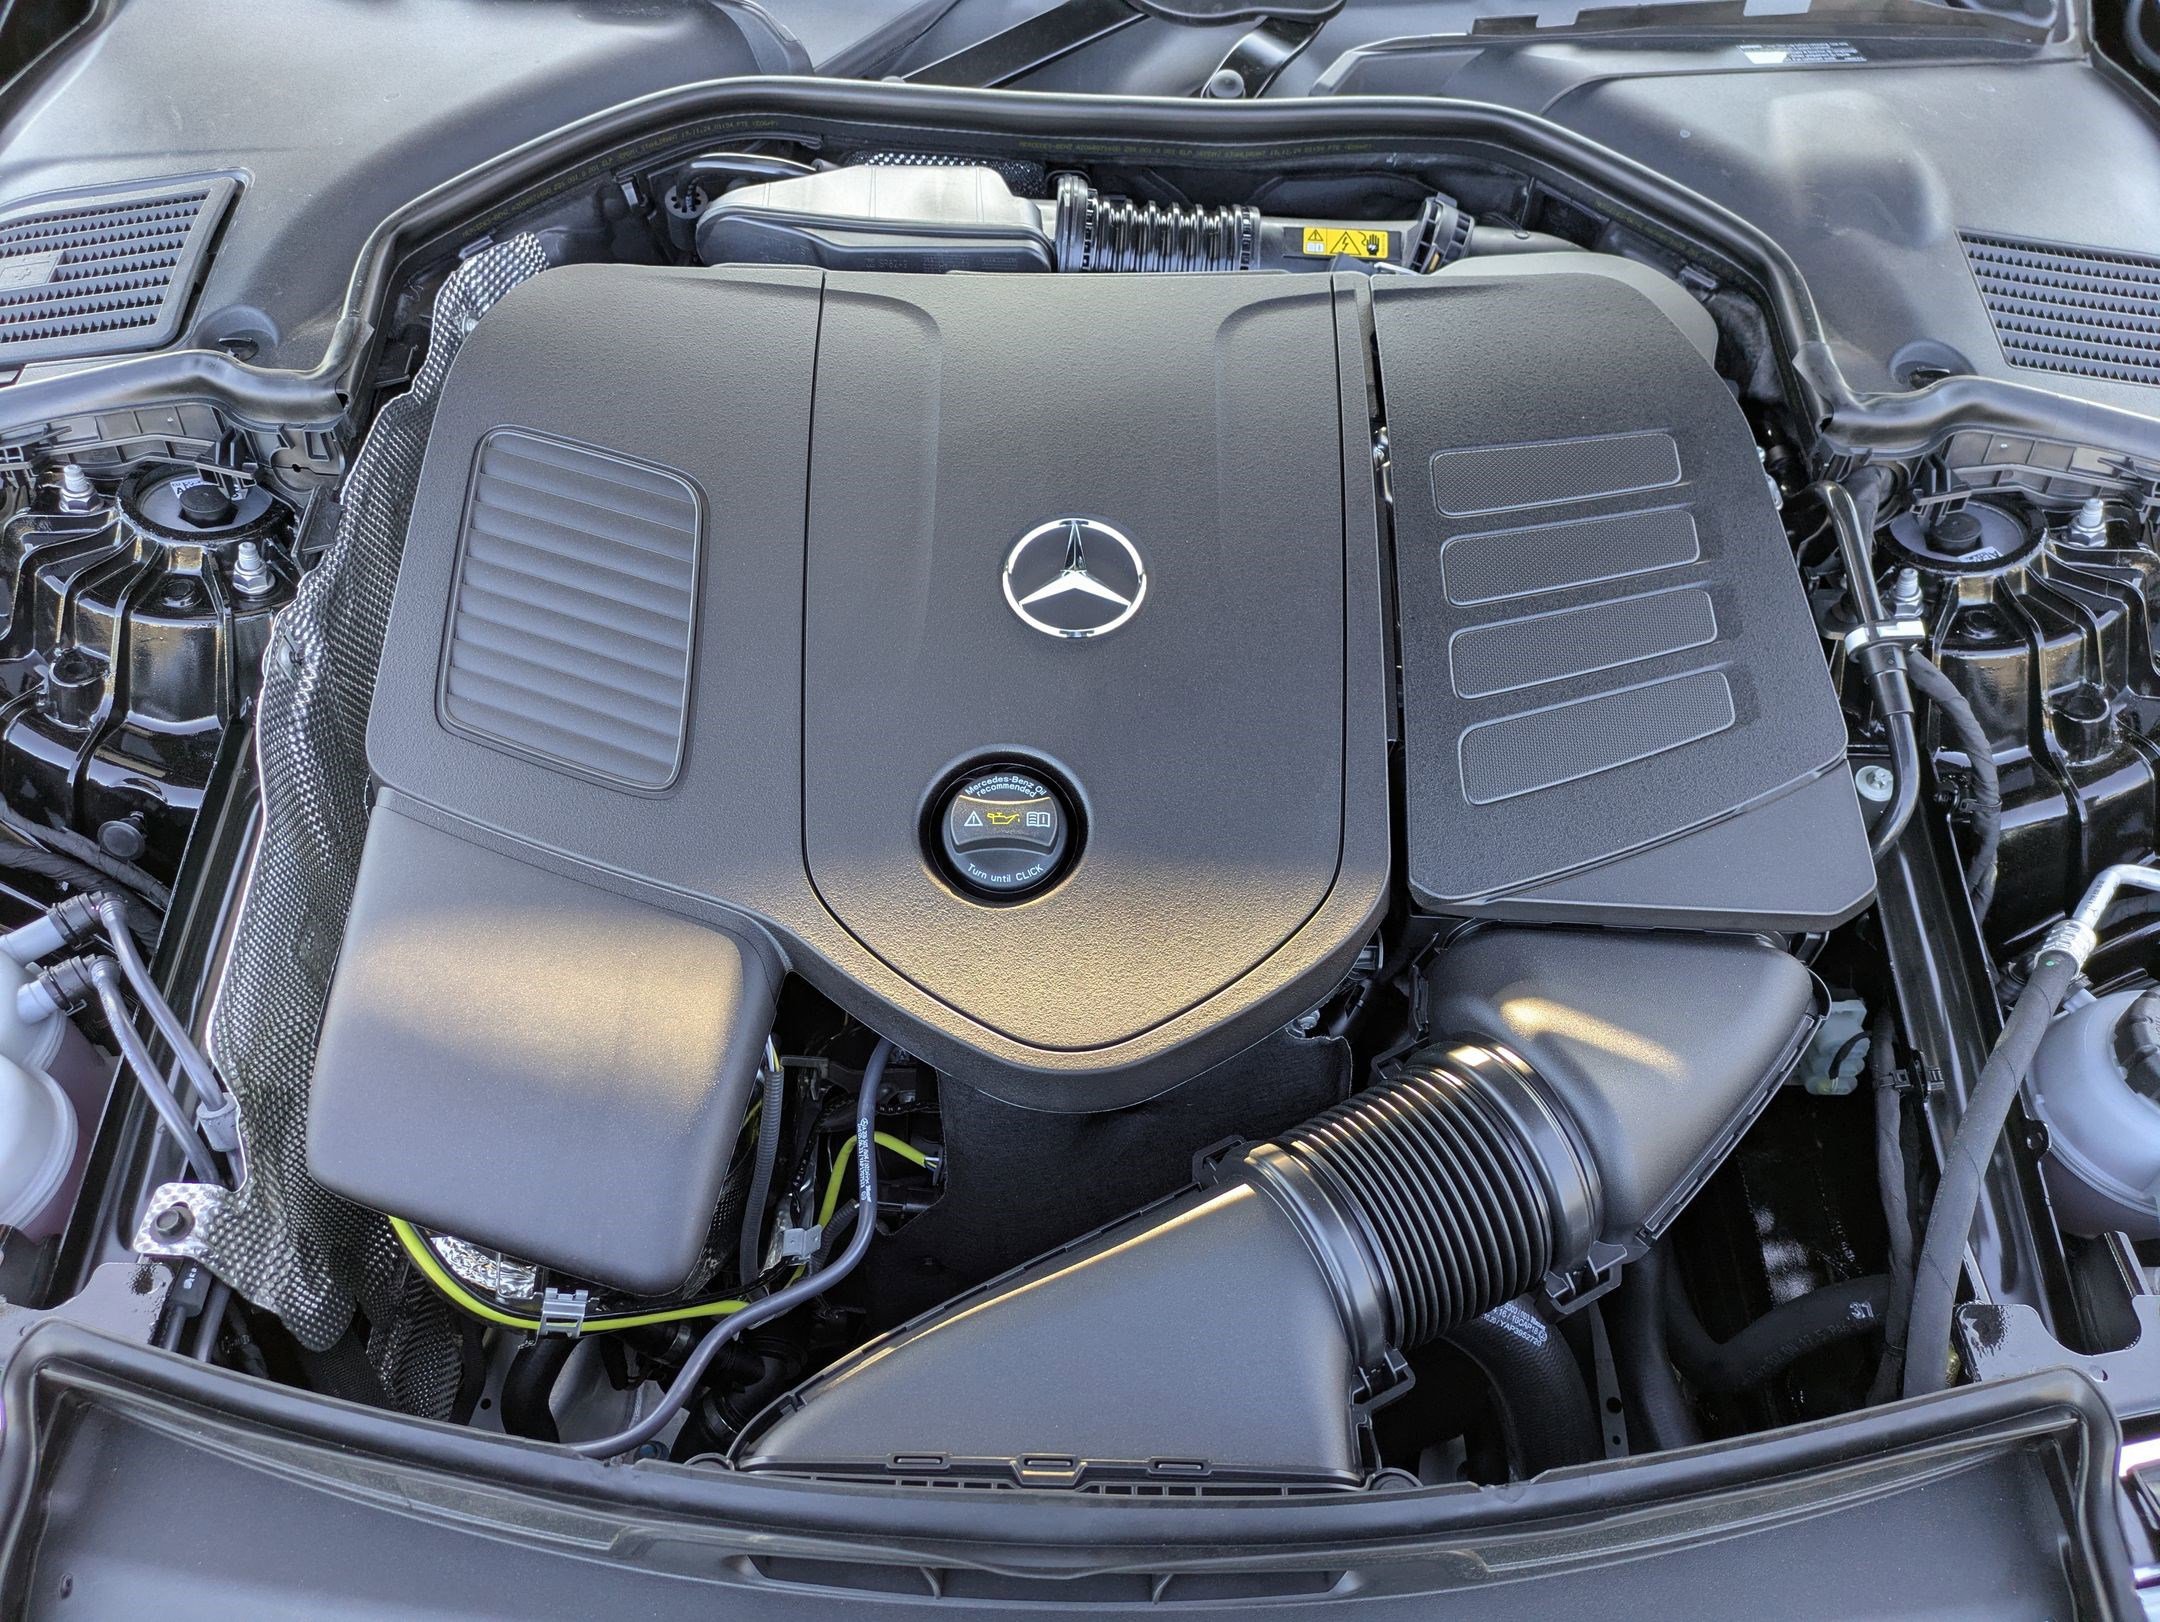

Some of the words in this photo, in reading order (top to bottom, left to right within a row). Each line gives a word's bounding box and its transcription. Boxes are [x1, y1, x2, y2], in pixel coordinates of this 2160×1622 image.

[964, 776, 1034, 795] Mercedes-Benz
[1035, 785, 1047, 796] Oil
[976, 783, 1037, 798] recommended
[967, 863, 987, 879] Turn
[990, 874, 1011, 883] until
[1015, 864, 1044, 881] CLICK
